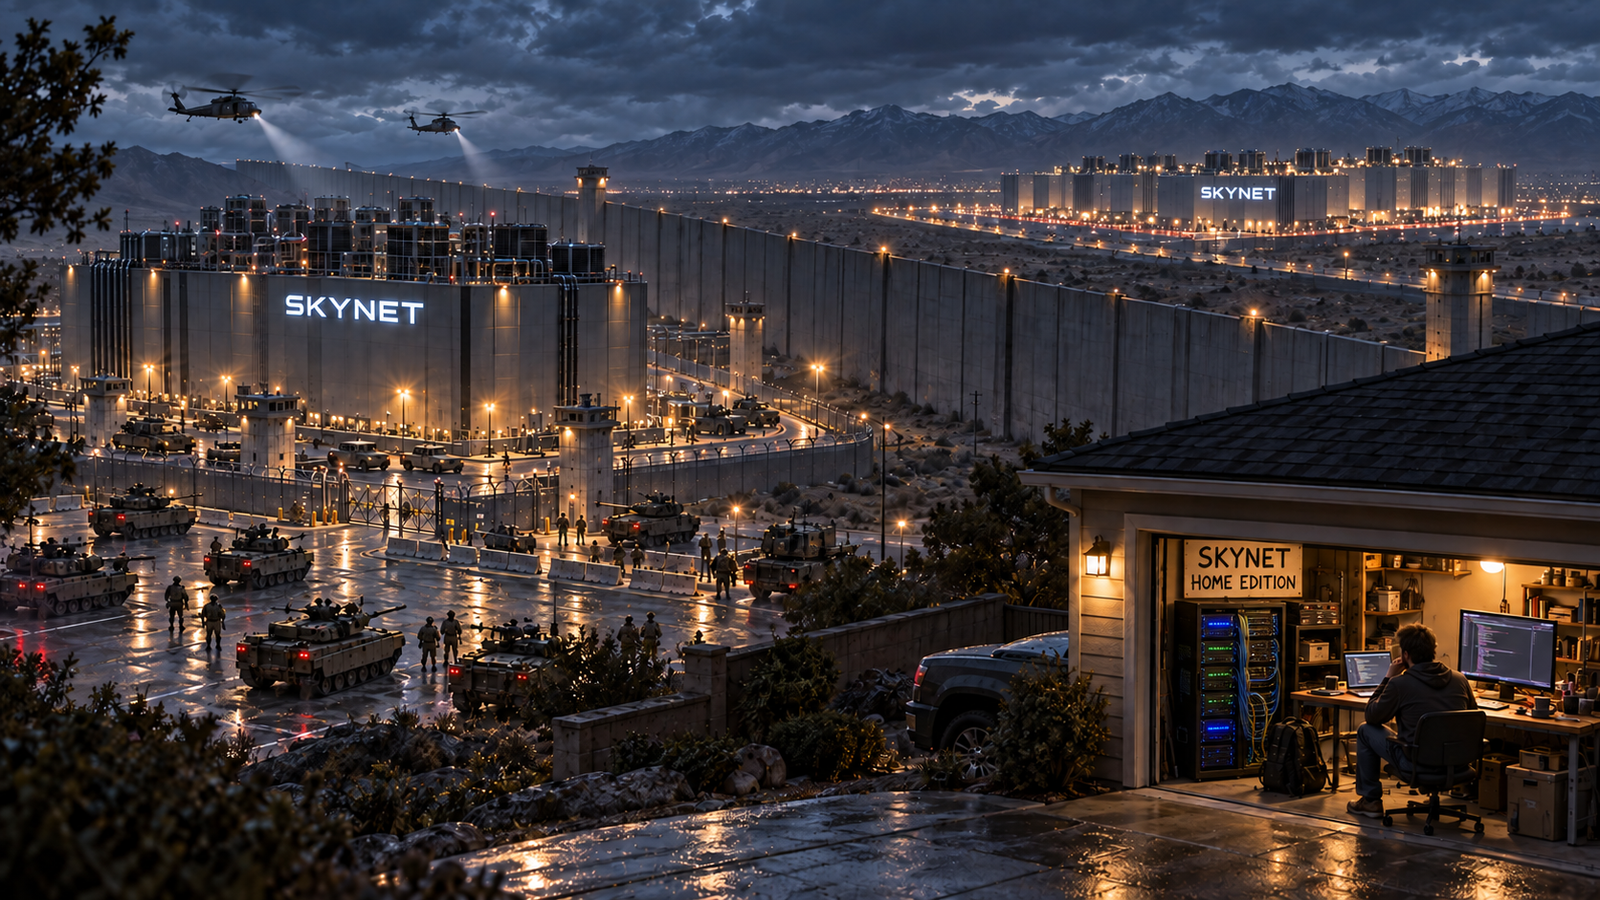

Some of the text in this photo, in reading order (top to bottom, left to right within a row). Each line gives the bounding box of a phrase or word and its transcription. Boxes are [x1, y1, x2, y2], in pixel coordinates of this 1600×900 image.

[1200, 186, 1277, 201] SKYNET
[285, 294, 424, 325] SKYNET
[1198, 545, 1291, 569] SKYNET
[1191, 574, 1296, 591] HOME EDITION
